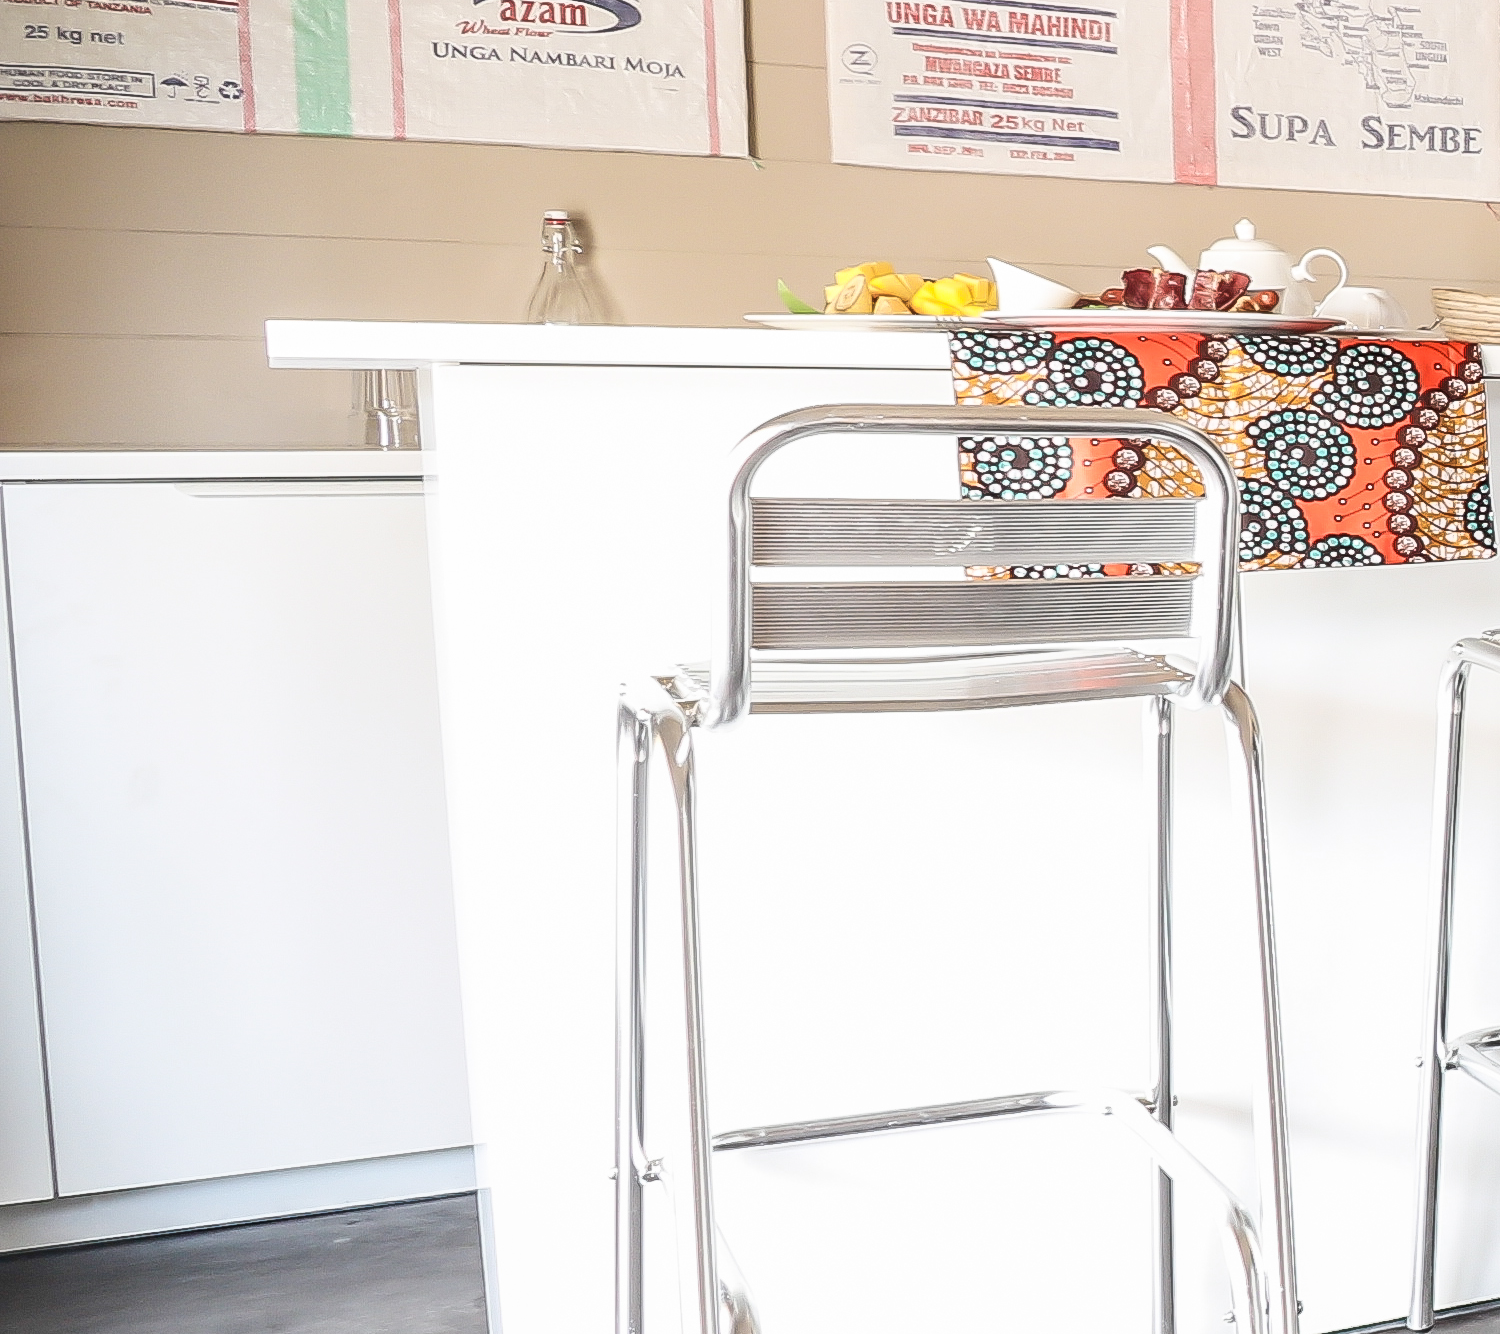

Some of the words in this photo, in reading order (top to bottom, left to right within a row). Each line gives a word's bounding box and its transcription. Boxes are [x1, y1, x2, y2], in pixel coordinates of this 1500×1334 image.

[86, 0, 152, 15] TANZANIA
[886, 1, 954, 28] UNGA
[961, 7, 1004, 33] WA
[1008, 11, 1112, 43] MAHINDI
[24, 24, 49, 40] 25
[57, 26, 82, 45] kg
[90, 31, 125, 45] net
[431, 42, 503, 62] UNGA
[509, 46, 616, 71] NAMBARI
[624, 56, 686, 80] MOJA
[1258, 47, 1282, 58] WEST
[49, 69, 83, 80] FOOD
[87, 72, 129, 83] STORE
[925, 56, 1010, 80] MWANGAZA
[1013, 64, 1063, 84] SEMBE
[63, 79, 87, 89] DRY
[91, 83, 132, 93] PLACE
[891, 107, 984, 127] ZANZIBAR
[1052, 118, 1086, 133] Net
[1231, 105, 1337, 147] SUPA
[1361, 115, 1483, 154] SEMBE
